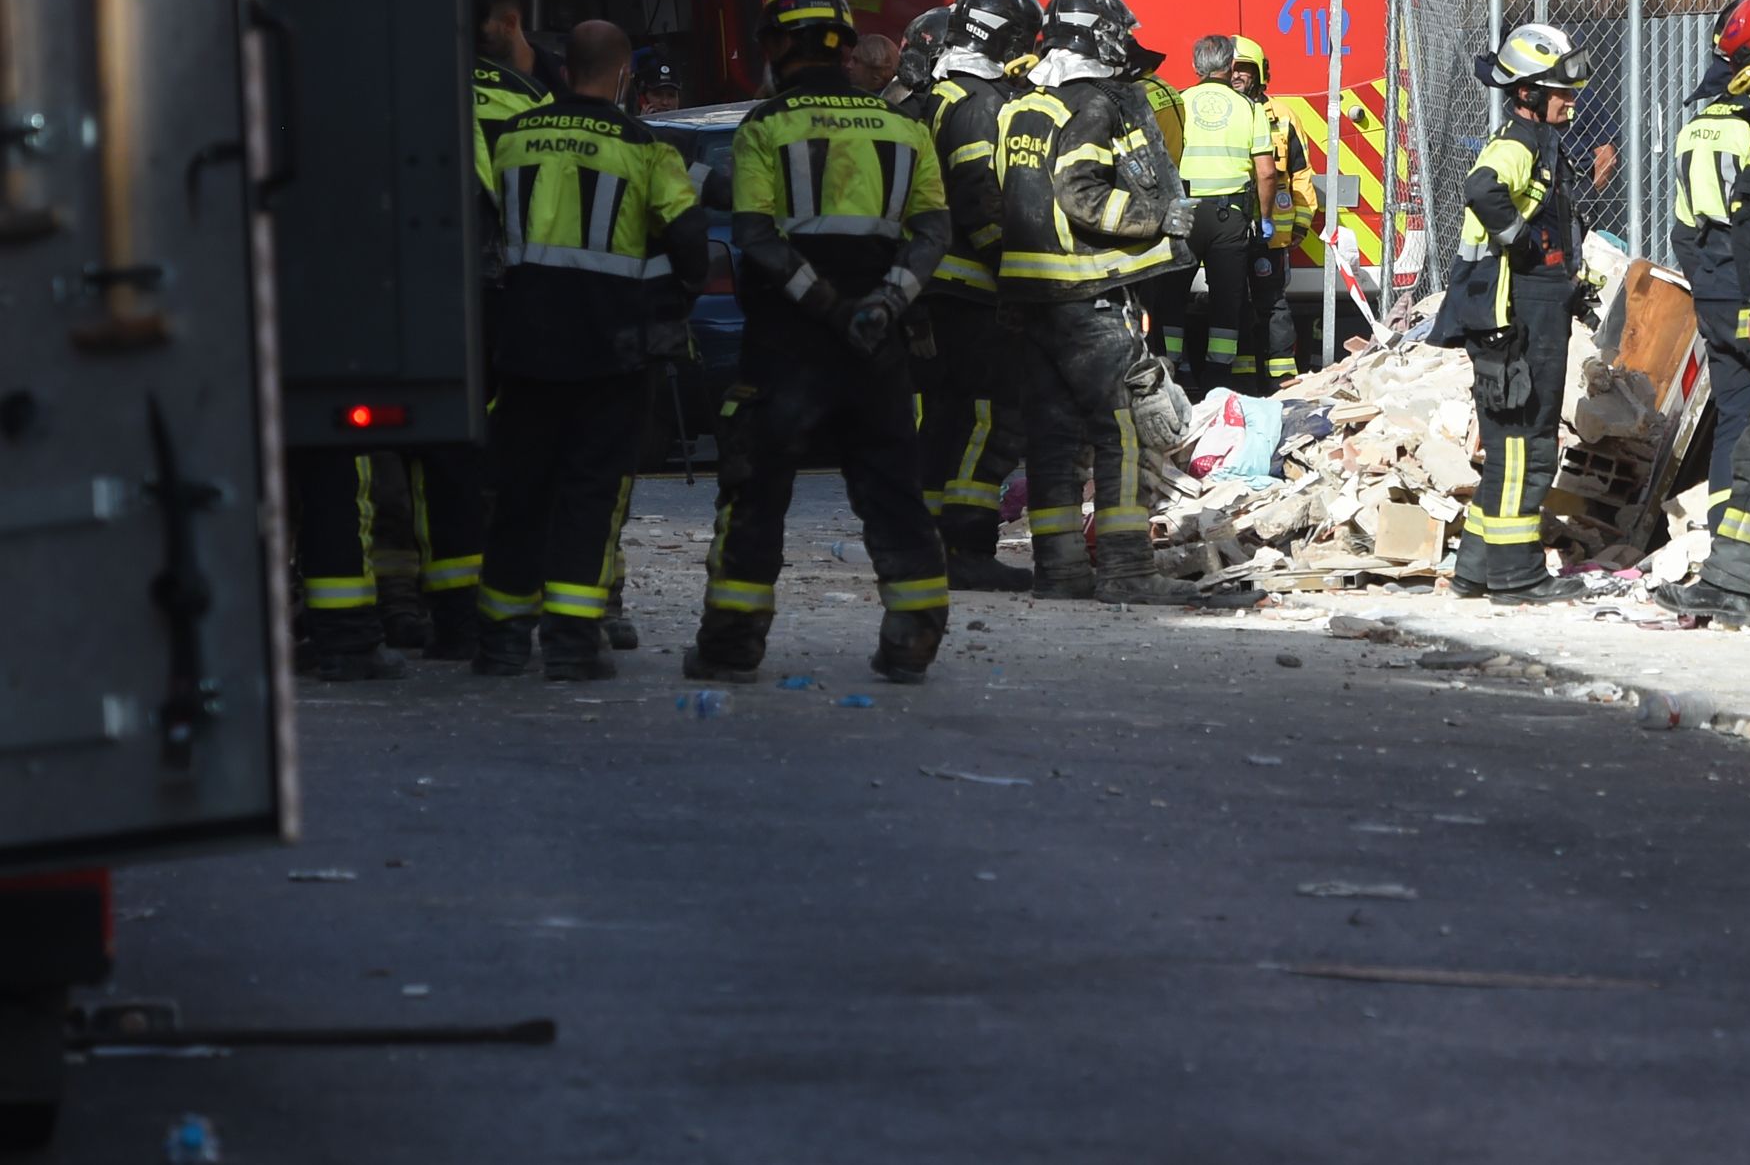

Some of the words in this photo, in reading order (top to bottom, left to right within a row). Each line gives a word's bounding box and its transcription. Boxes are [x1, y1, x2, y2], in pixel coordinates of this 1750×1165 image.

[786, 95, 888, 110] BOMBEROS
[517, 115, 622, 135] BOMBEROS
[811, 115, 885, 130] MADRID
[525, 137, 598, 157] MADRID
